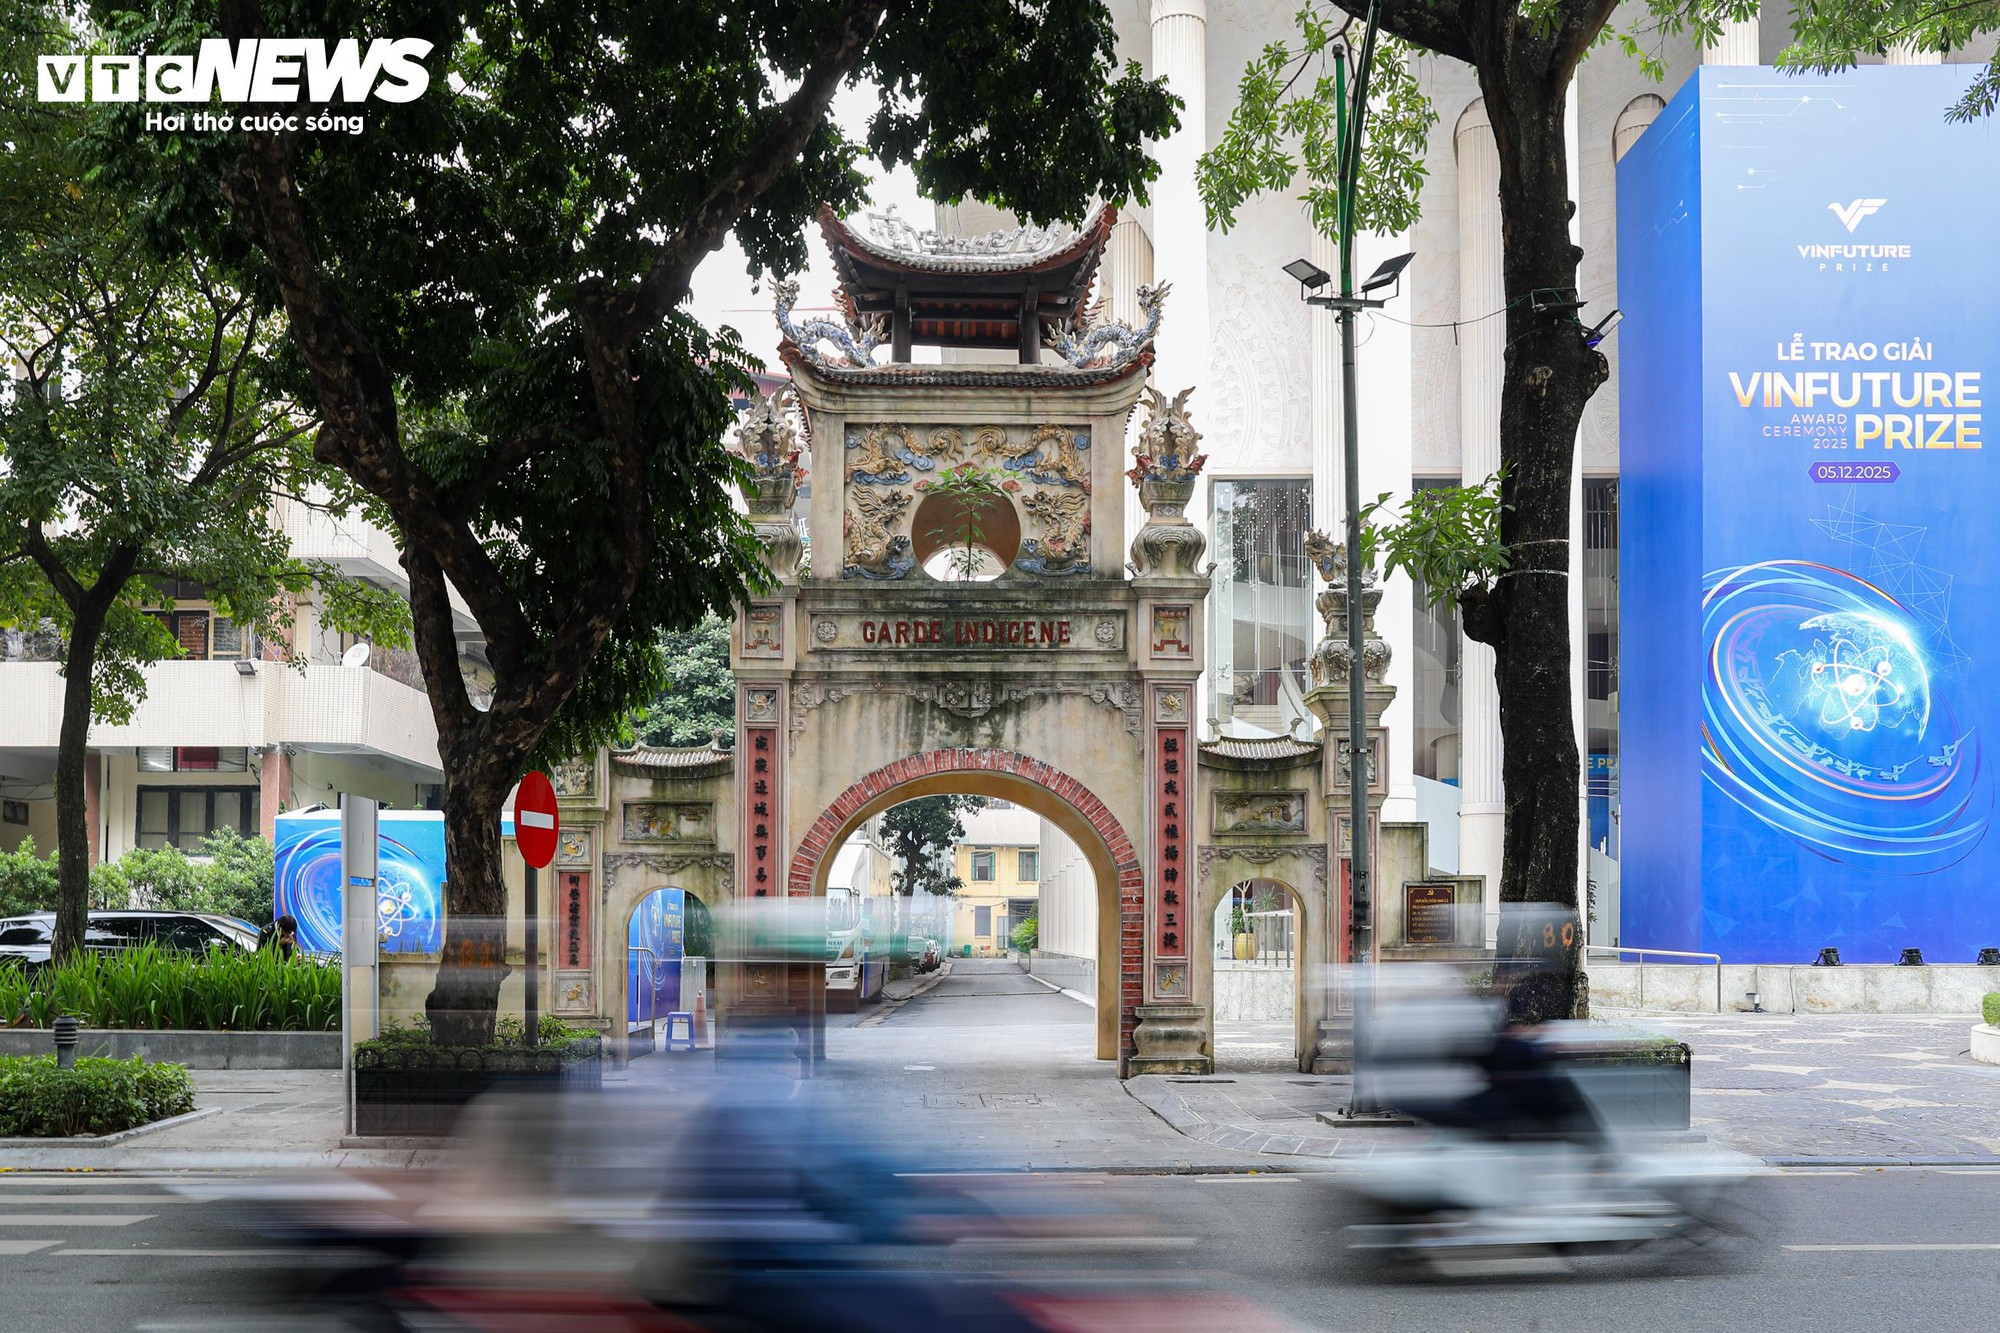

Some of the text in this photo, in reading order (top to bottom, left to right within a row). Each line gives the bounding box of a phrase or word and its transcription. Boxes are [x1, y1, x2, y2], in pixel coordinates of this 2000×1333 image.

[1798, 244, 1911, 259] VINFUTURE
[1820, 263, 1889, 272] PRIZE
[1777, 333, 1932, 361] LỄ TRAO GIẢI
[1728, 372, 1982, 408] VINFUTURE
[1790, 413, 1847, 425] AWARD
[1762, 425, 1848, 437] CEREMONY
[1855, 413, 1982, 449] PRIZE
[1813, 438, 1848, 449] 2025
[1817, 466, 1891, 480] 05.12.2025
[862, 621, 1071, 643] GARDE INDIGENE
